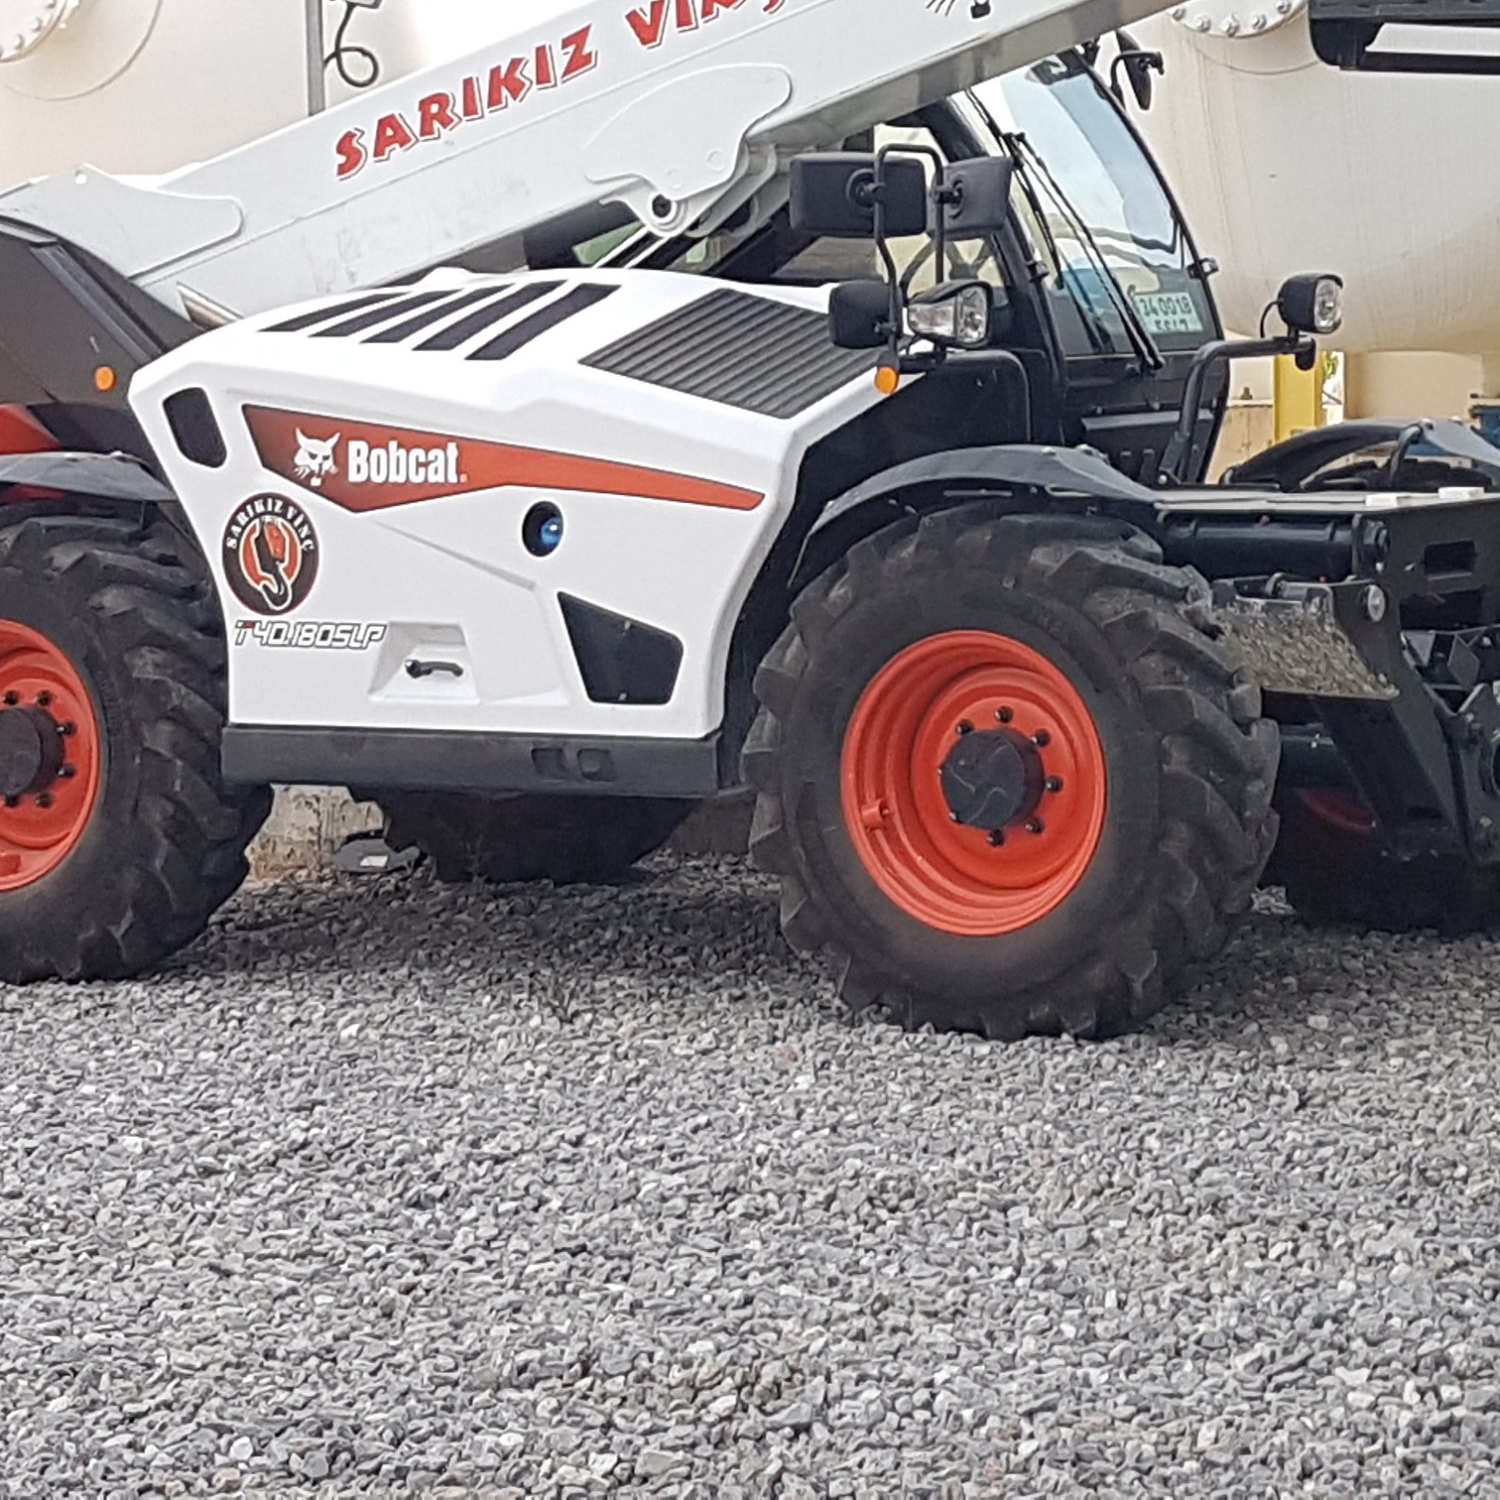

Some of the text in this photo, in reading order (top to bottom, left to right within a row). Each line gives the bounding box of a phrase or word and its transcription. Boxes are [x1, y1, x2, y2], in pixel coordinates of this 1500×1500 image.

[336, 23, 599, 180] SARIKIZ
[348, 440, 459, 483] Bobcat
[226, 498, 284, 550] SARIKIZ
